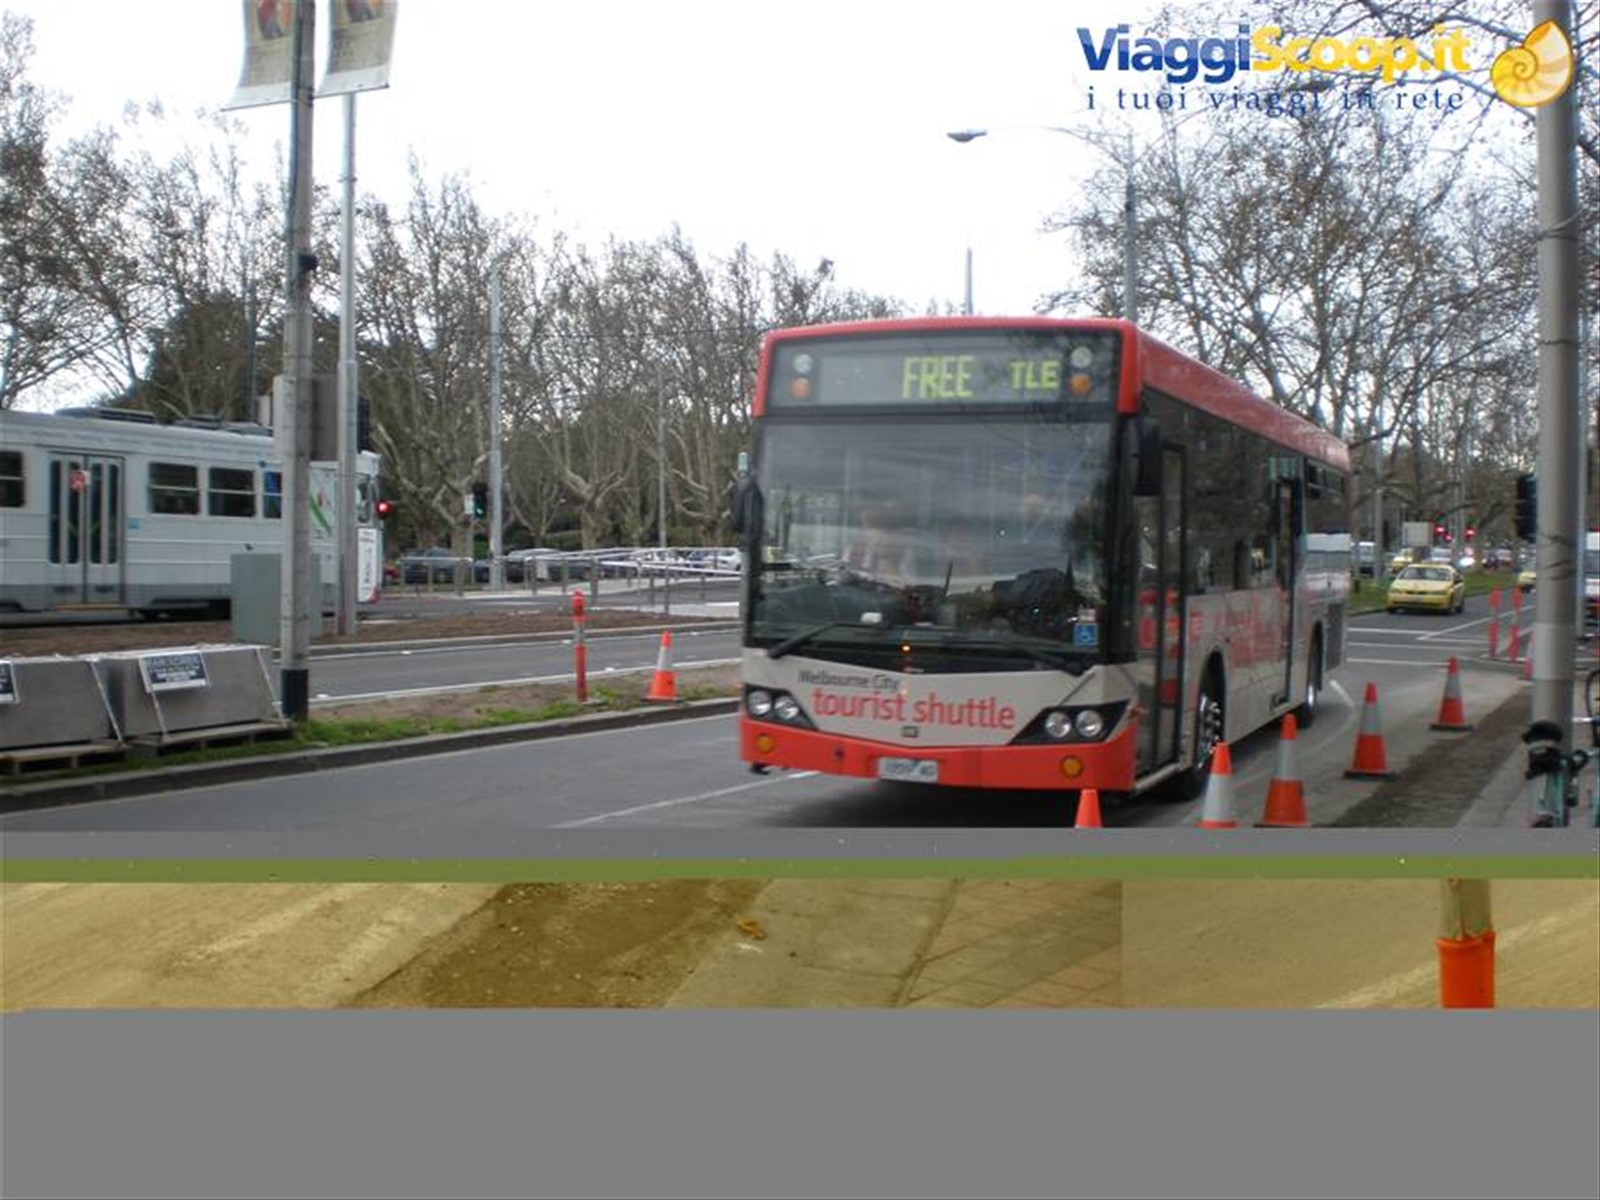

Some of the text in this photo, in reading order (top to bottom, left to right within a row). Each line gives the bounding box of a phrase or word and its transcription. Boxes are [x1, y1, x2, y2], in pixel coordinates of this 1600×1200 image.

[903, 356, 1061, 398] FREE TLE
[873, 674, 899, 693] City
[812, 688, 1015, 730] tourist shuttle
